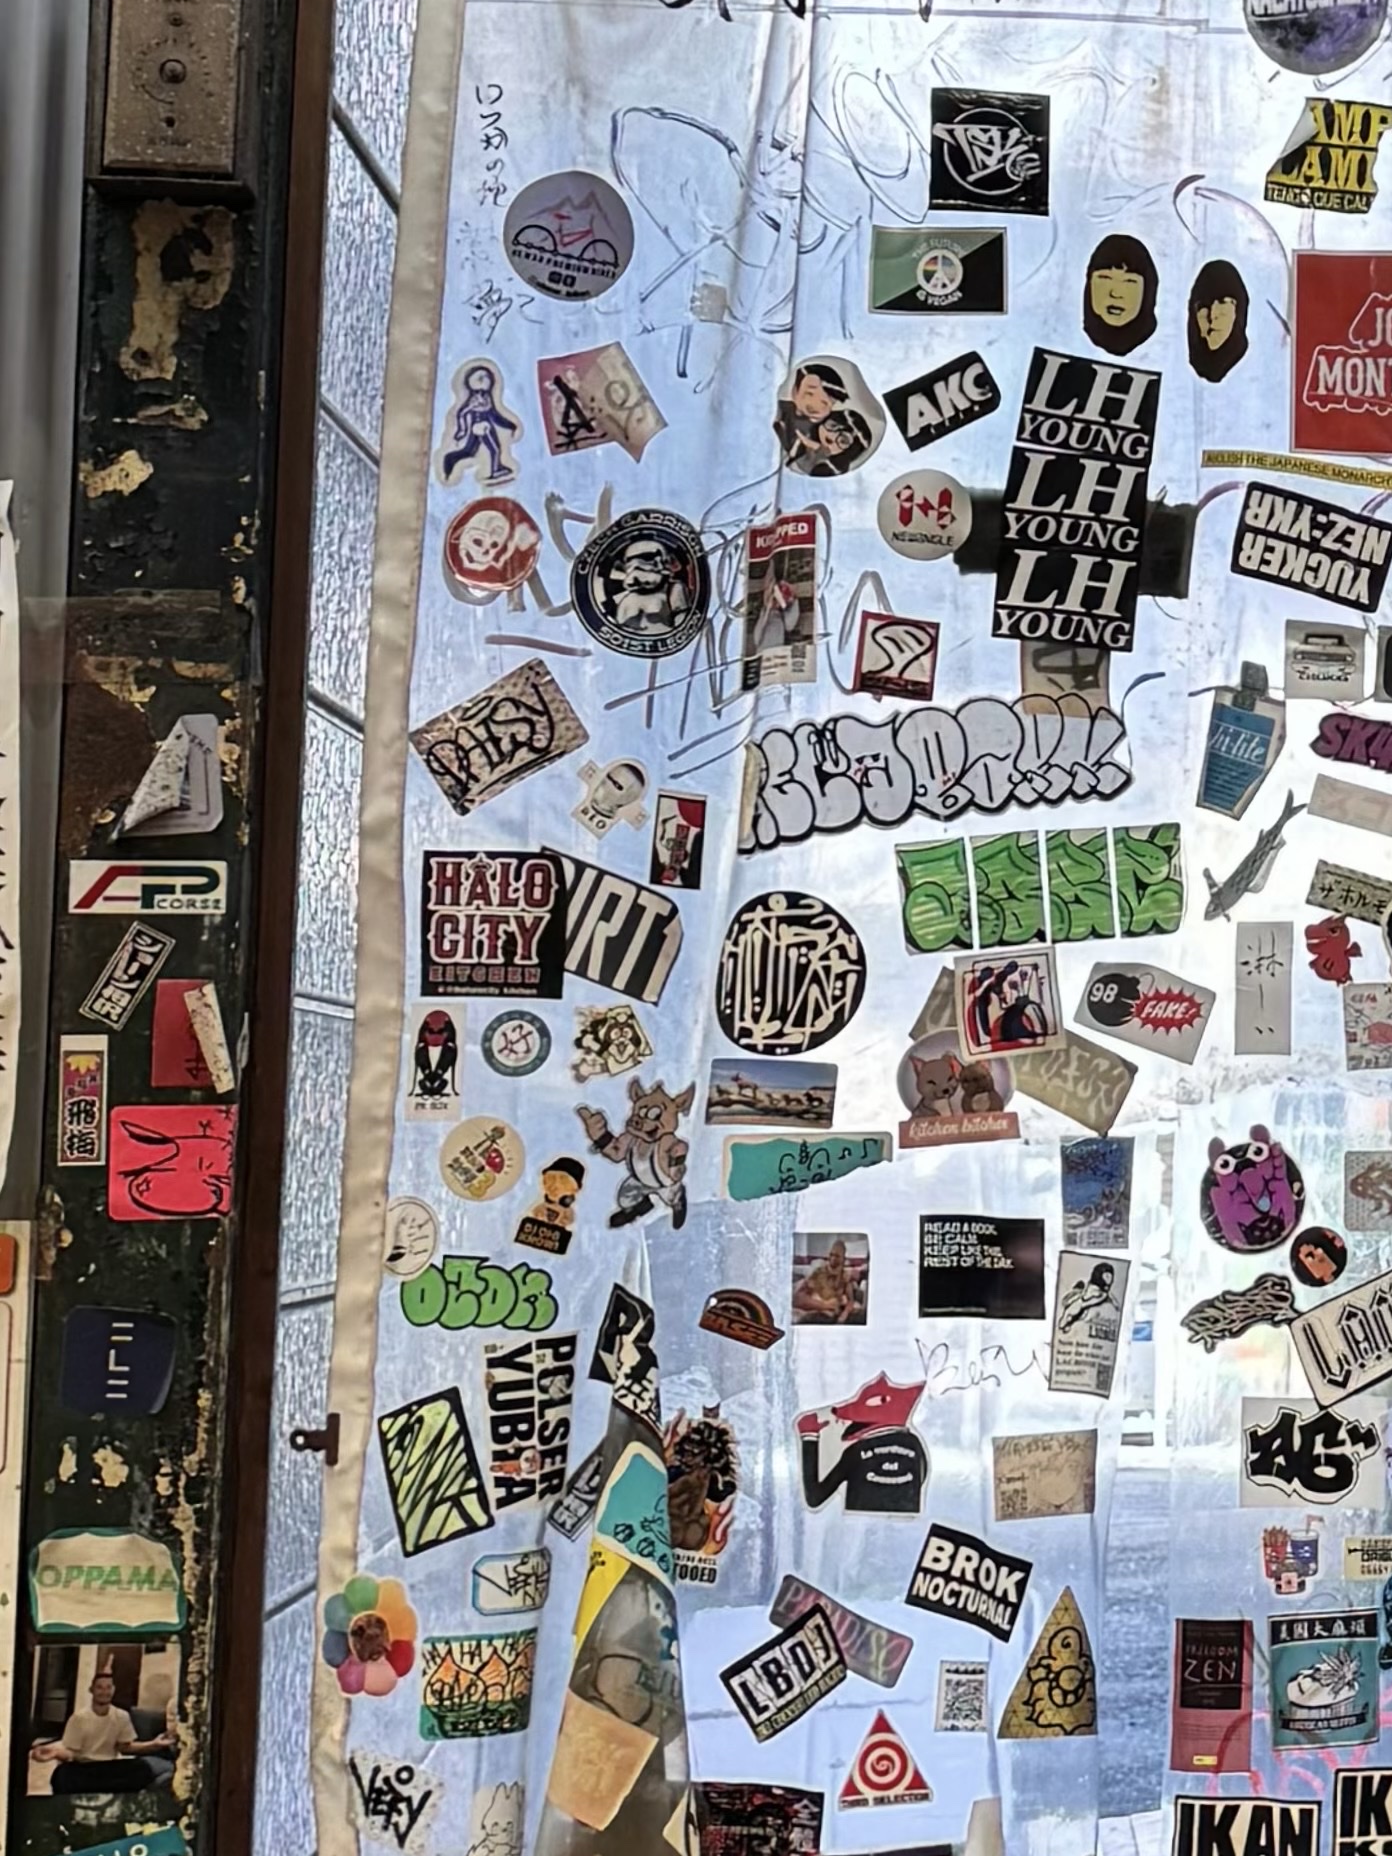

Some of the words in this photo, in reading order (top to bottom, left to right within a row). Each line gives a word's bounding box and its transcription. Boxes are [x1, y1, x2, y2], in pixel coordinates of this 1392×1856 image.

[1024, 353, 1160, 430] LH
[1020, 412, 1150, 460] YOUNG
[1006, 452, 1147, 523] LH
[1004, 510, 1140, 553] YOUNG
[997, 549, 1138, 617] LH
[1237, 531, 1372, 605] YUCKER
[996, 609, 1133, 648] YOUNG
[428, 855, 559, 909] HALO
[428, 912, 550, 964] CITY
[428, 965, 542, 984] KITCHEN
[1087, 982, 1118, 1004] 98
[1138, 998, 1197, 1021] FAKE!
[907, 1116, 962, 1141] kitchen
[35, 1560, 179, 1594] OPPAMA
[919, 1534, 1028, 1604] BROK
[911, 1573, 1014, 1633] NOCTURNAL
[1183, 1658, 1237, 1683] ZEN
